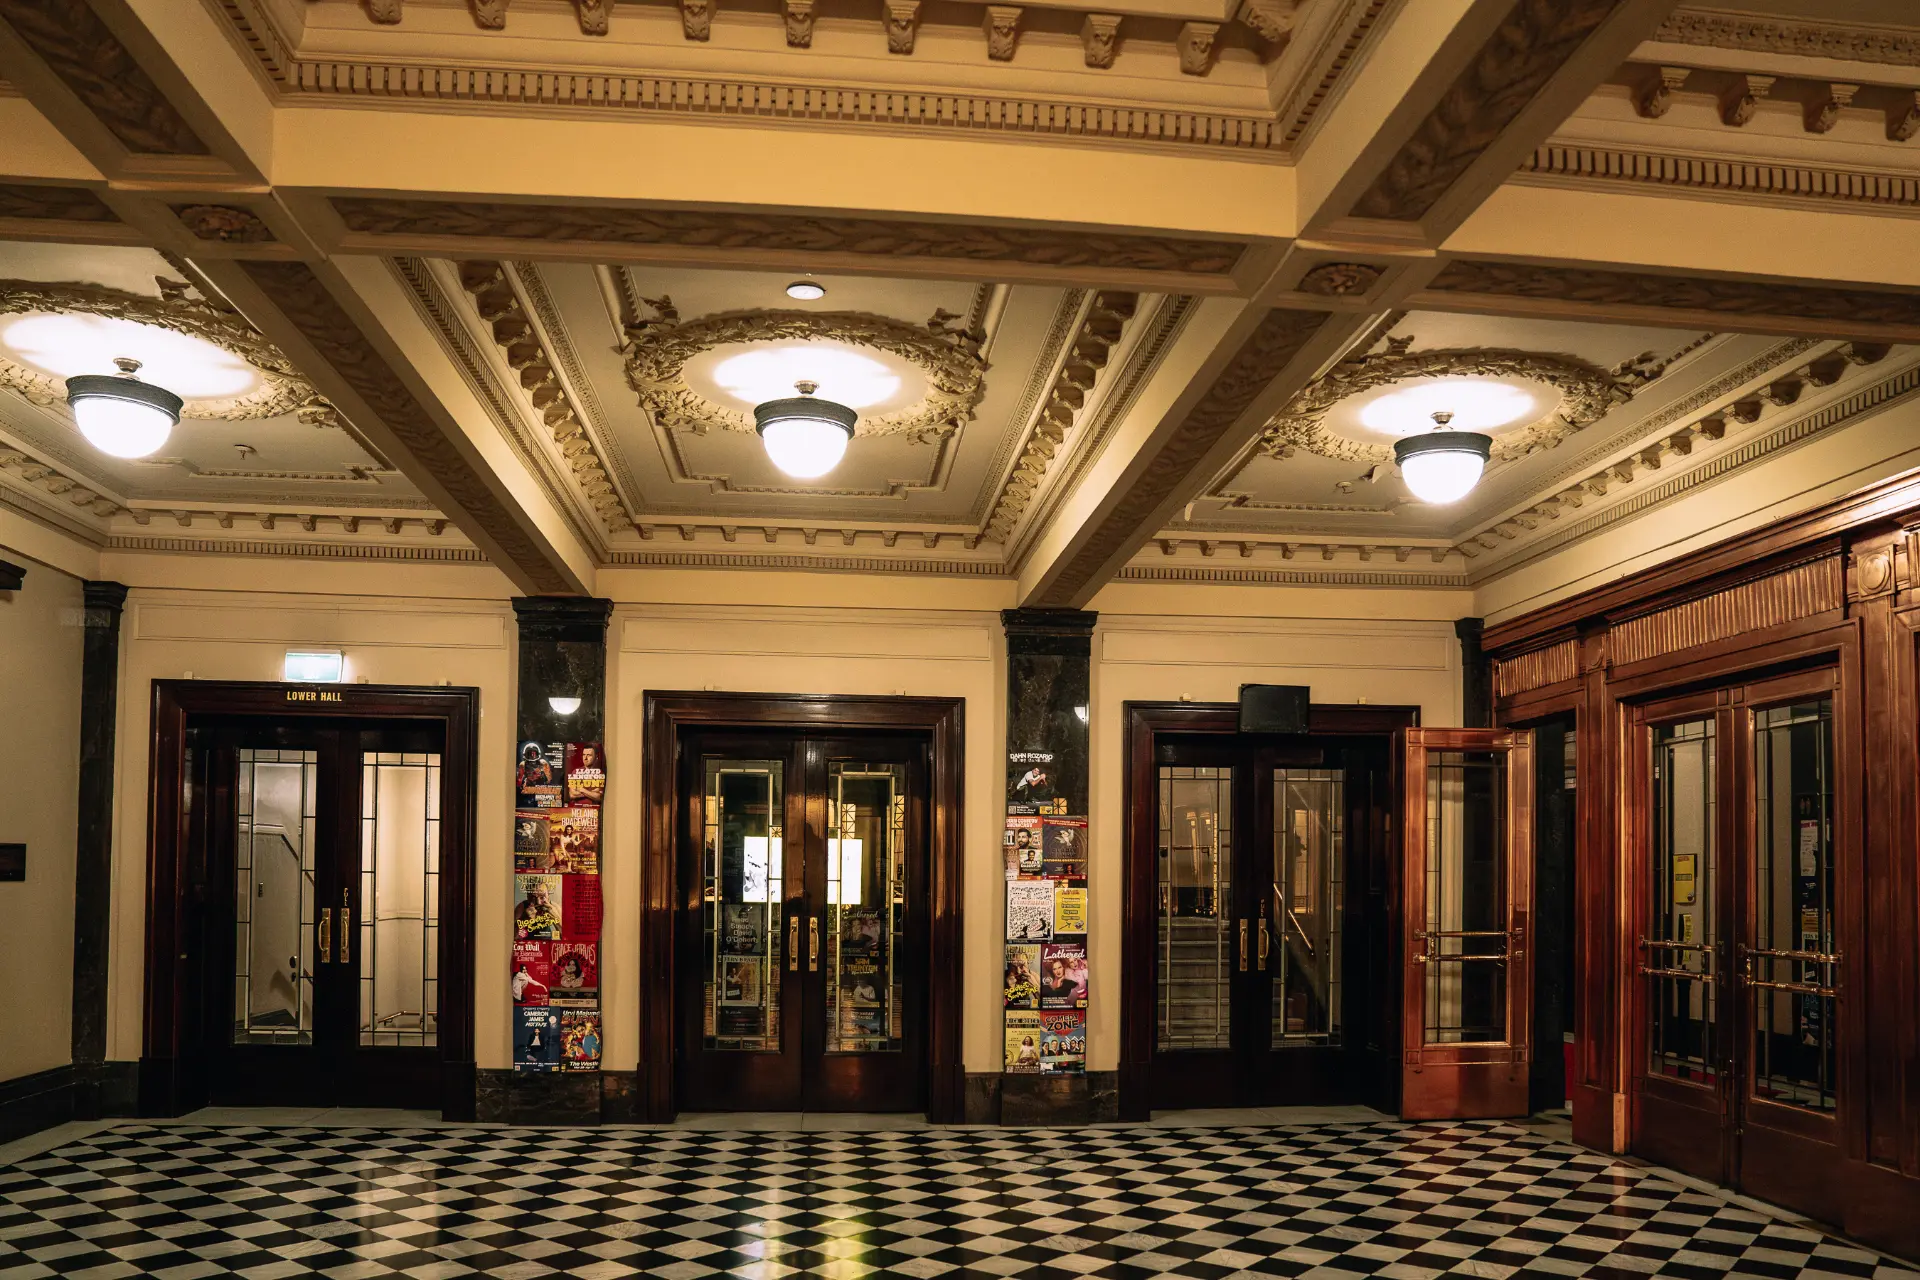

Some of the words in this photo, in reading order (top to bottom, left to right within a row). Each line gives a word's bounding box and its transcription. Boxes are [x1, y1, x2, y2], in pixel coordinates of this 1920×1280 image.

[287, 691, 316, 701] LOWER
[320, 692, 342, 702] HALL
[551, 943, 572, 964] GRACE
[573, 943, 596, 965] JARVIS
[1043, 948, 1085, 960] Lathered
[1045, 1013, 1079, 1023] COMEDY
[1047, 1020, 1079, 1031] ZONE
